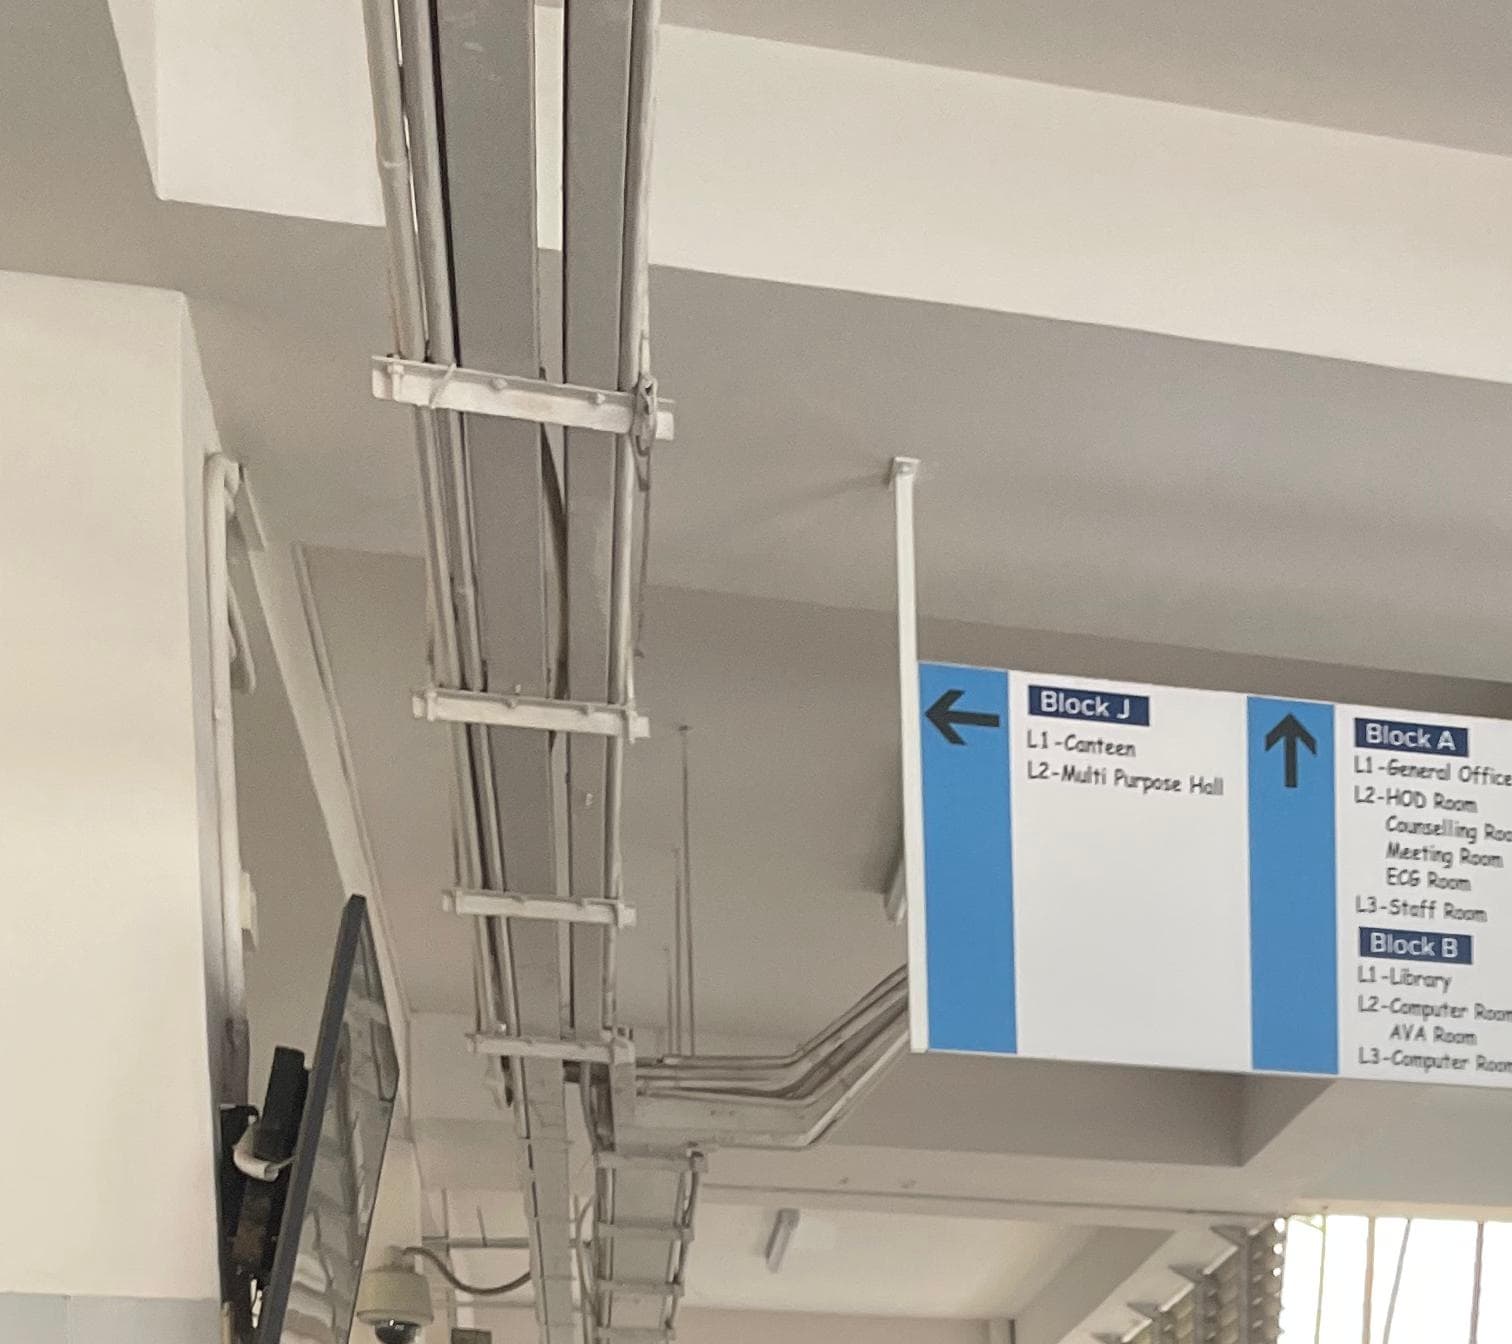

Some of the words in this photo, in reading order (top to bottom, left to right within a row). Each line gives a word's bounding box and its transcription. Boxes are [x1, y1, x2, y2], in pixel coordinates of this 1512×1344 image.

[1041, 690, 1109, 717] Block
[1116, 698, 1130, 720] J
[1365, 722, 1431, 748] Block
[1437, 730, 1456, 751] A
[1114, 769, 1181, 794] Purpose
[1190, 776, 1223, 795] Hall
[1458, 766, 1512, 786] Office
[1434, 792, 1477, 812] Room
[1386, 815, 1477, 844] Counselling
[1386, 842, 1453, 868] Meeting
[1460, 848, 1503, 867] Room
[1387, 867, 1420, 887] ECG
[1428, 871, 1471, 890] Room
[1444, 902, 1487, 922] Room
[1371, 931, 1436, 957] Block
[1441, 937, 1458, 958] B
[1390, 1025, 1426, 1041] AVA
[1434, 1026, 1477, 1045] Room
